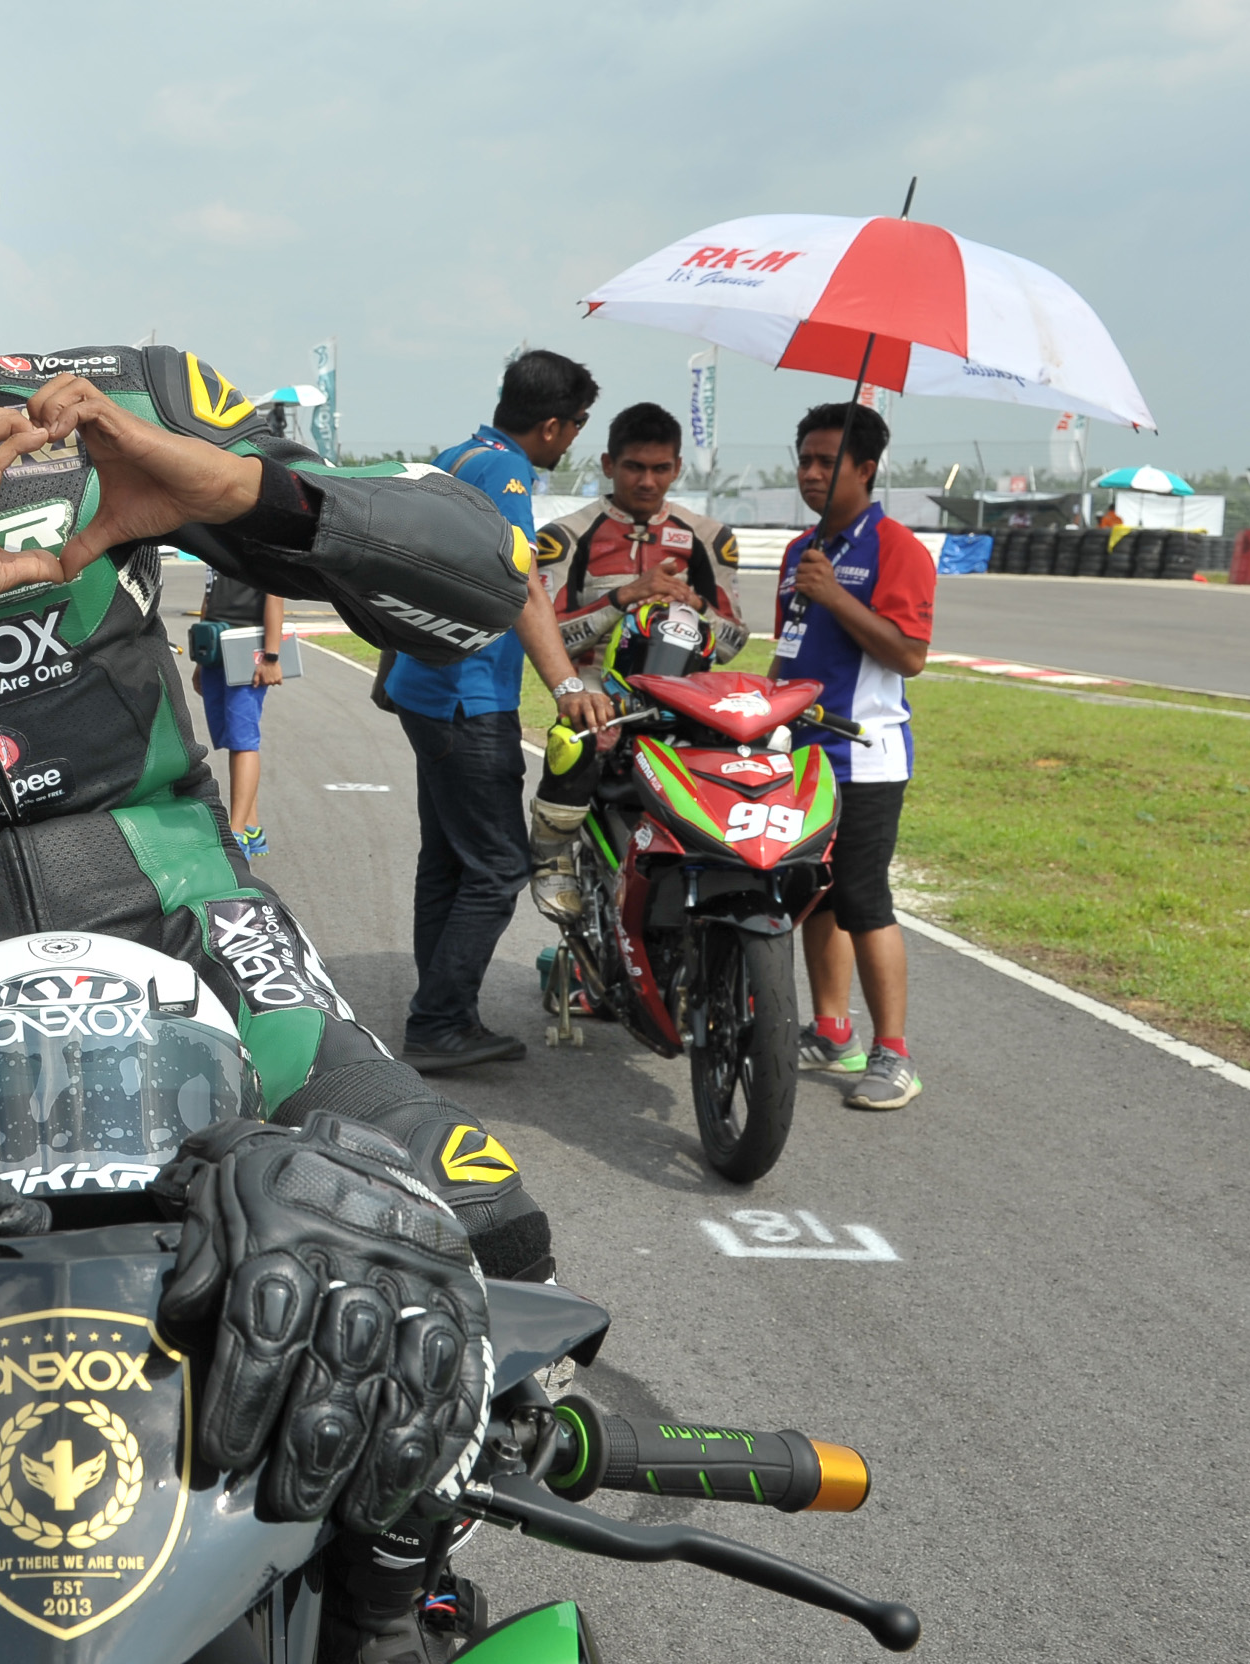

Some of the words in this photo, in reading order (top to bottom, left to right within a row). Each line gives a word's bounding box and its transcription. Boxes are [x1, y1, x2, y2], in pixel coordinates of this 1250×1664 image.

[681, 246, 801, 273] RK-M
[34, 356, 117, 371] Voopee
[0, 674, 31, 696] Are
[35, 660, 74, 683] One
[724, 801, 805, 843] 99
[0, 975, 132, 1002] KYT
[17, 1554, 60, 1571] THERE
[63, 1554, 85, 1570] WE
[88, 1554, 114, 1571] ARE
[117, 1554, 145, 1571] ONE
[51, 1580, 85, 1597] EST
[42, 1597, 94, 1617] 2013
